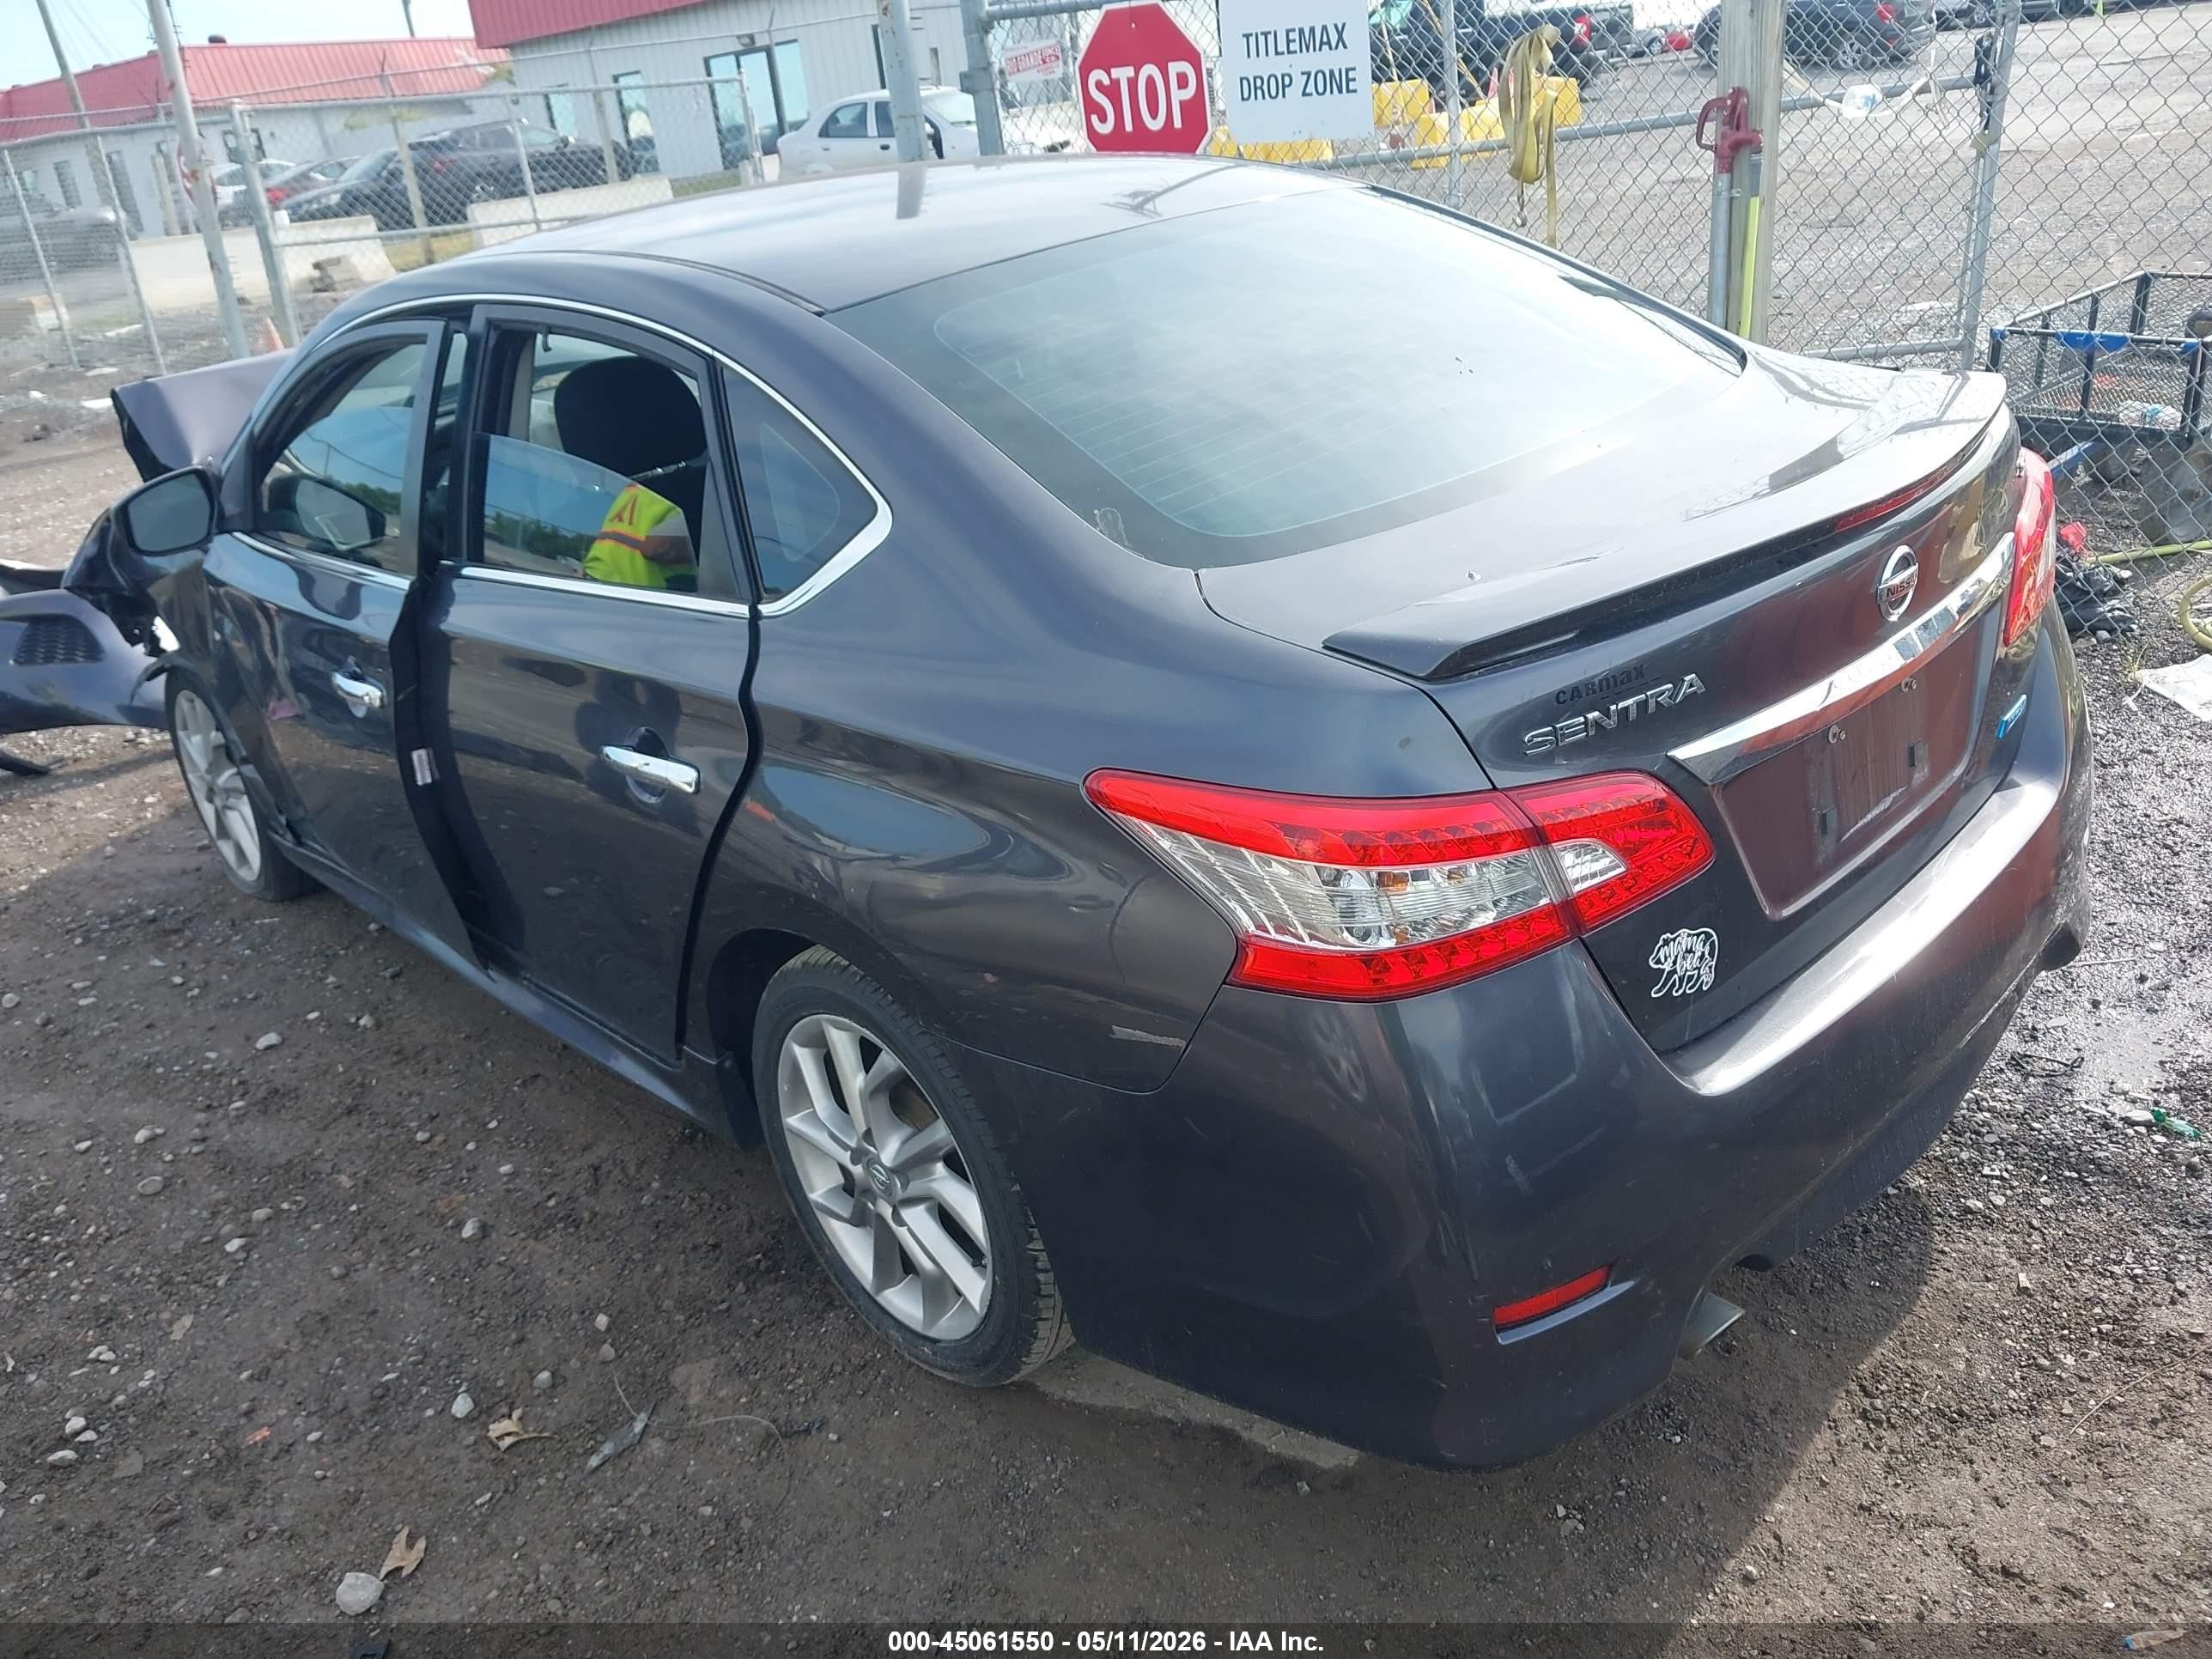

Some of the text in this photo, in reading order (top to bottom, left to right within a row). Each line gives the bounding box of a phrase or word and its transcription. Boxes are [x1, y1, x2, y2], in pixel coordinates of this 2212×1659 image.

[1243, 22, 1348, 59] TITLEMAX
[1087, 61, 1197, 134] STOP
[1239, 72, 1293, 102] DROP
[1301, 67, 1358, 97] ZONE
[1523, 673, 1705, 756] SENTRA
[1656, 933, 1708, 963] mama
